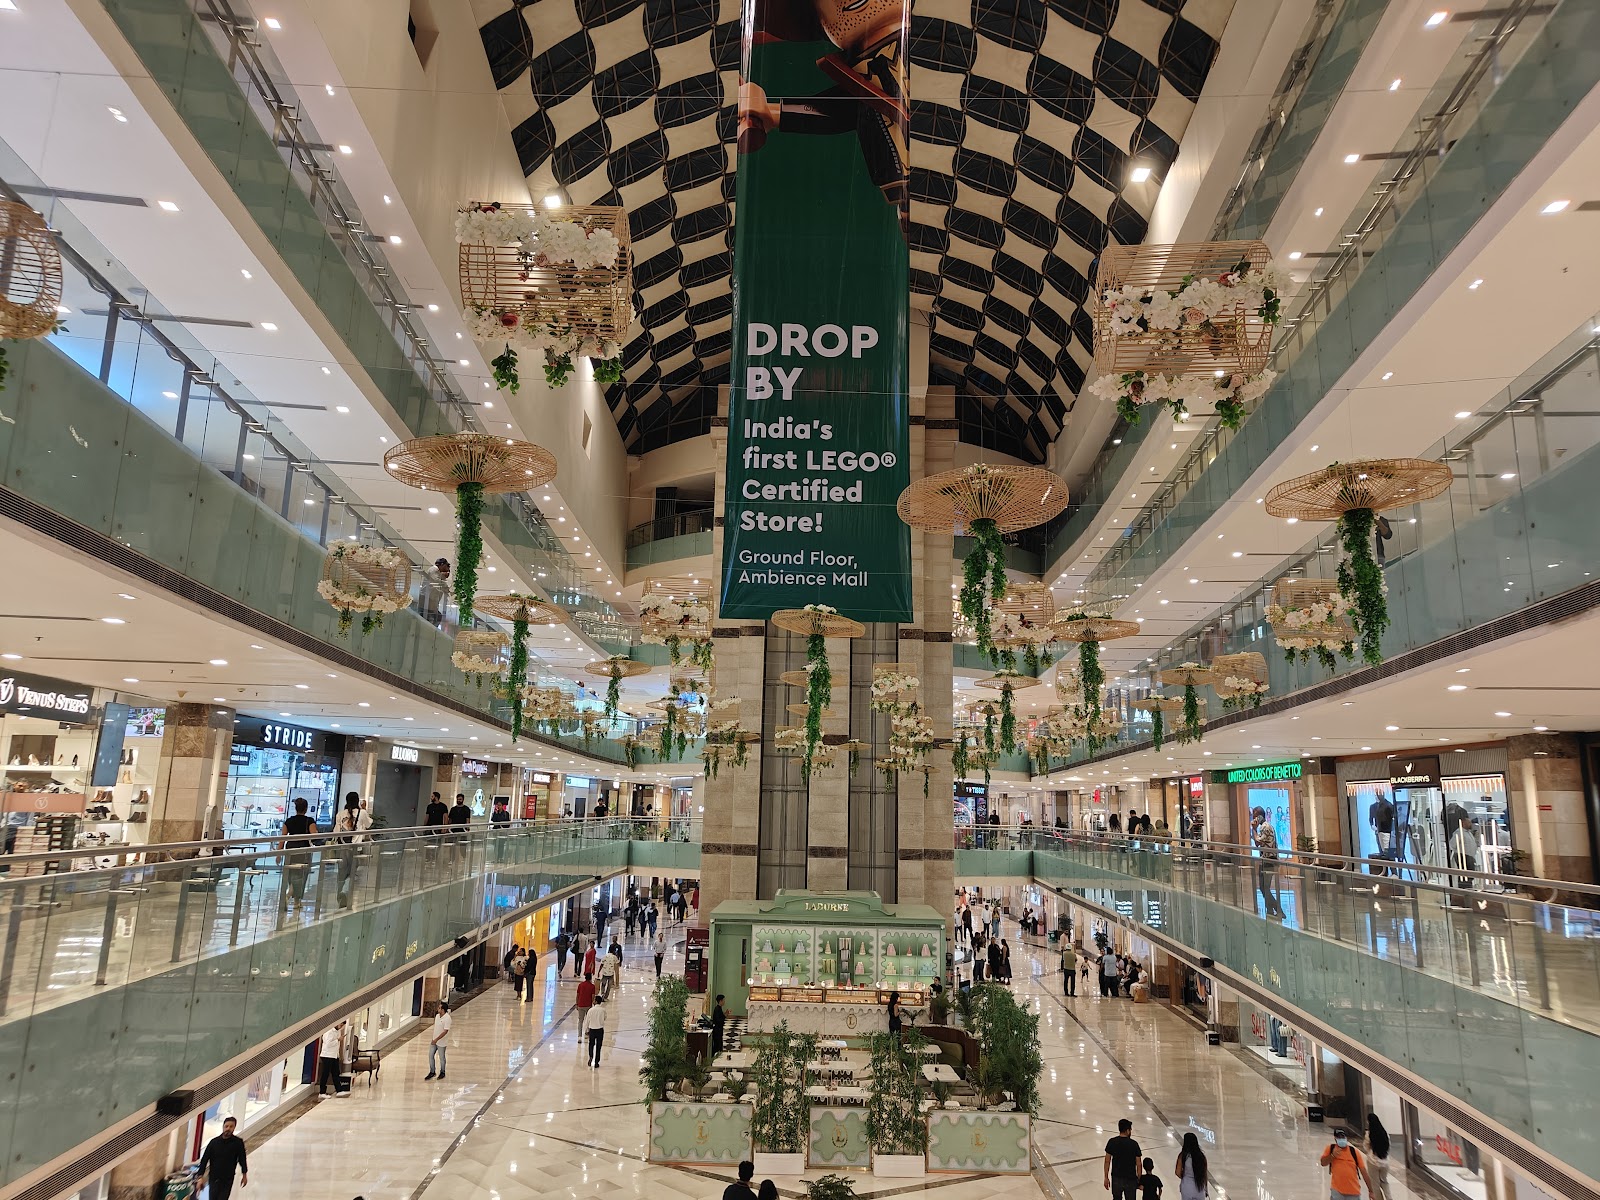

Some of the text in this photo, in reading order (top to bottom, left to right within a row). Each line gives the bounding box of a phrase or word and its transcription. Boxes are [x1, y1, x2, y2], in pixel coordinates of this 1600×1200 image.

[747, 322, 879, 358] DROP
[746, 366, 804, 401] BY
[744, 415, 833, 440] India's
[742, 445, 897, 472] first LEGO®
[742, 478, 863, 502] Certified
[740, 510, 823, 533] Store!
[738, 549, 858, 569] Ground Floor,
[738, 569, 868, 587] Ambience Mall
[264, 724, 313, 749] STRIDE
[1228, 770, 1246, 783] UNITED
[1245, 768, 1266, 781] COLORS
[1265, 766, 1274, 779] OF
[1390, 775, 1431, 784] BLACKBERRYS
[1251, 1013, 1266, 1041] SALE
[1436, 1134, 1464, 1168] SALE
[167, 1182, 187, 1192] FOOD
